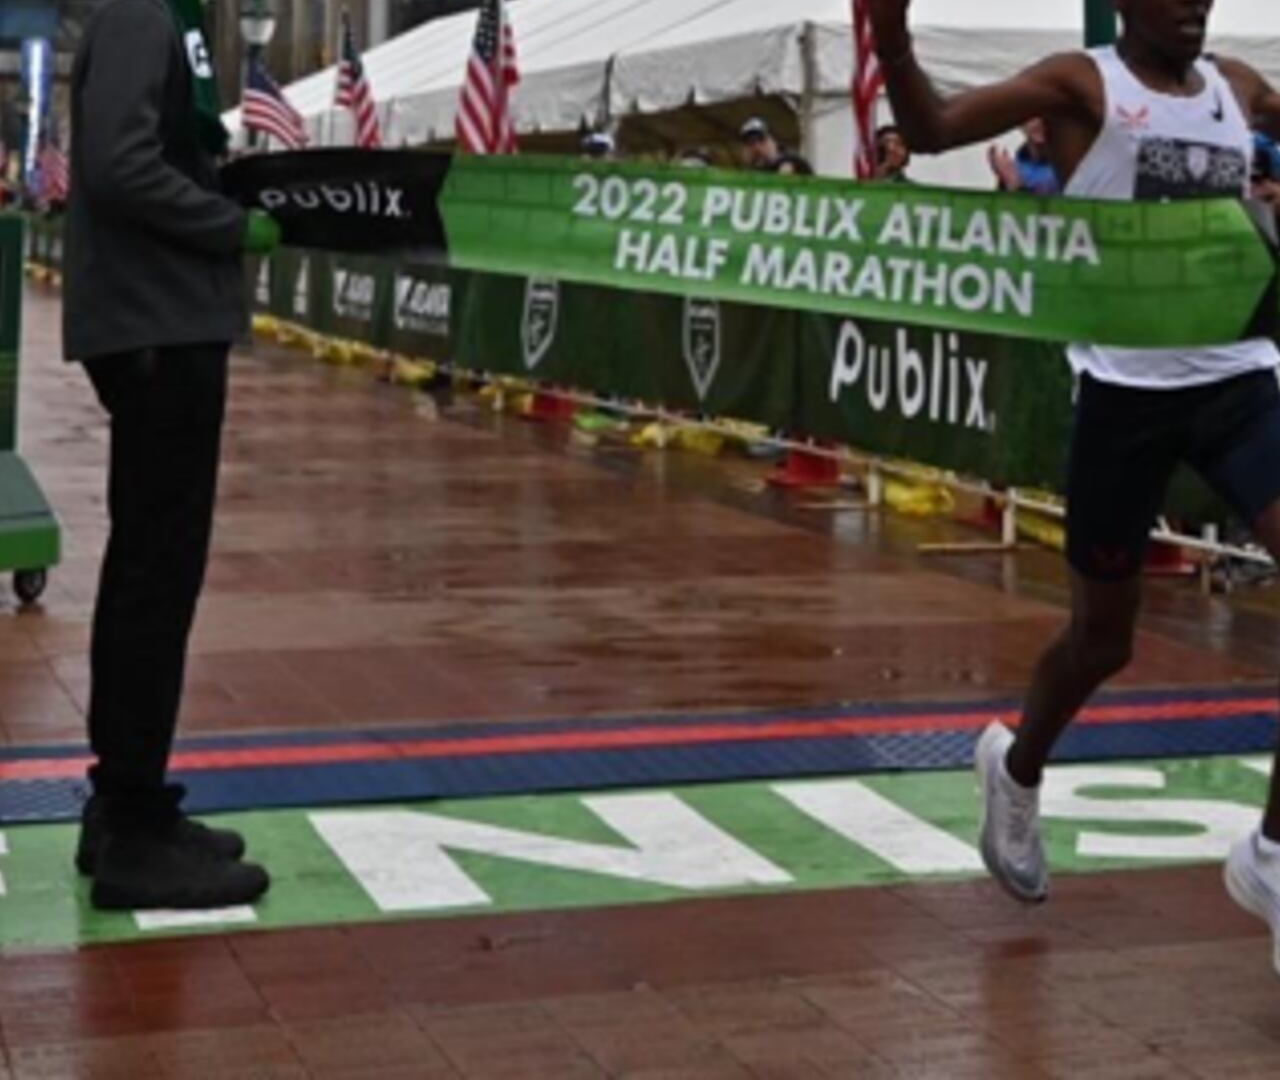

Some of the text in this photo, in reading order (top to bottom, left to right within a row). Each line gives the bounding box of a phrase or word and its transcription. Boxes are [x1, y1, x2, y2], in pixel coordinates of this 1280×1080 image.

[259, 181, 407, 218] Publix
[570, 172, 1101, 266] 2022 PUBLIX ATLANTA
[613, 228, 1035, 318] HALF MARATHON
[828, 319, 989, 432] Publix
